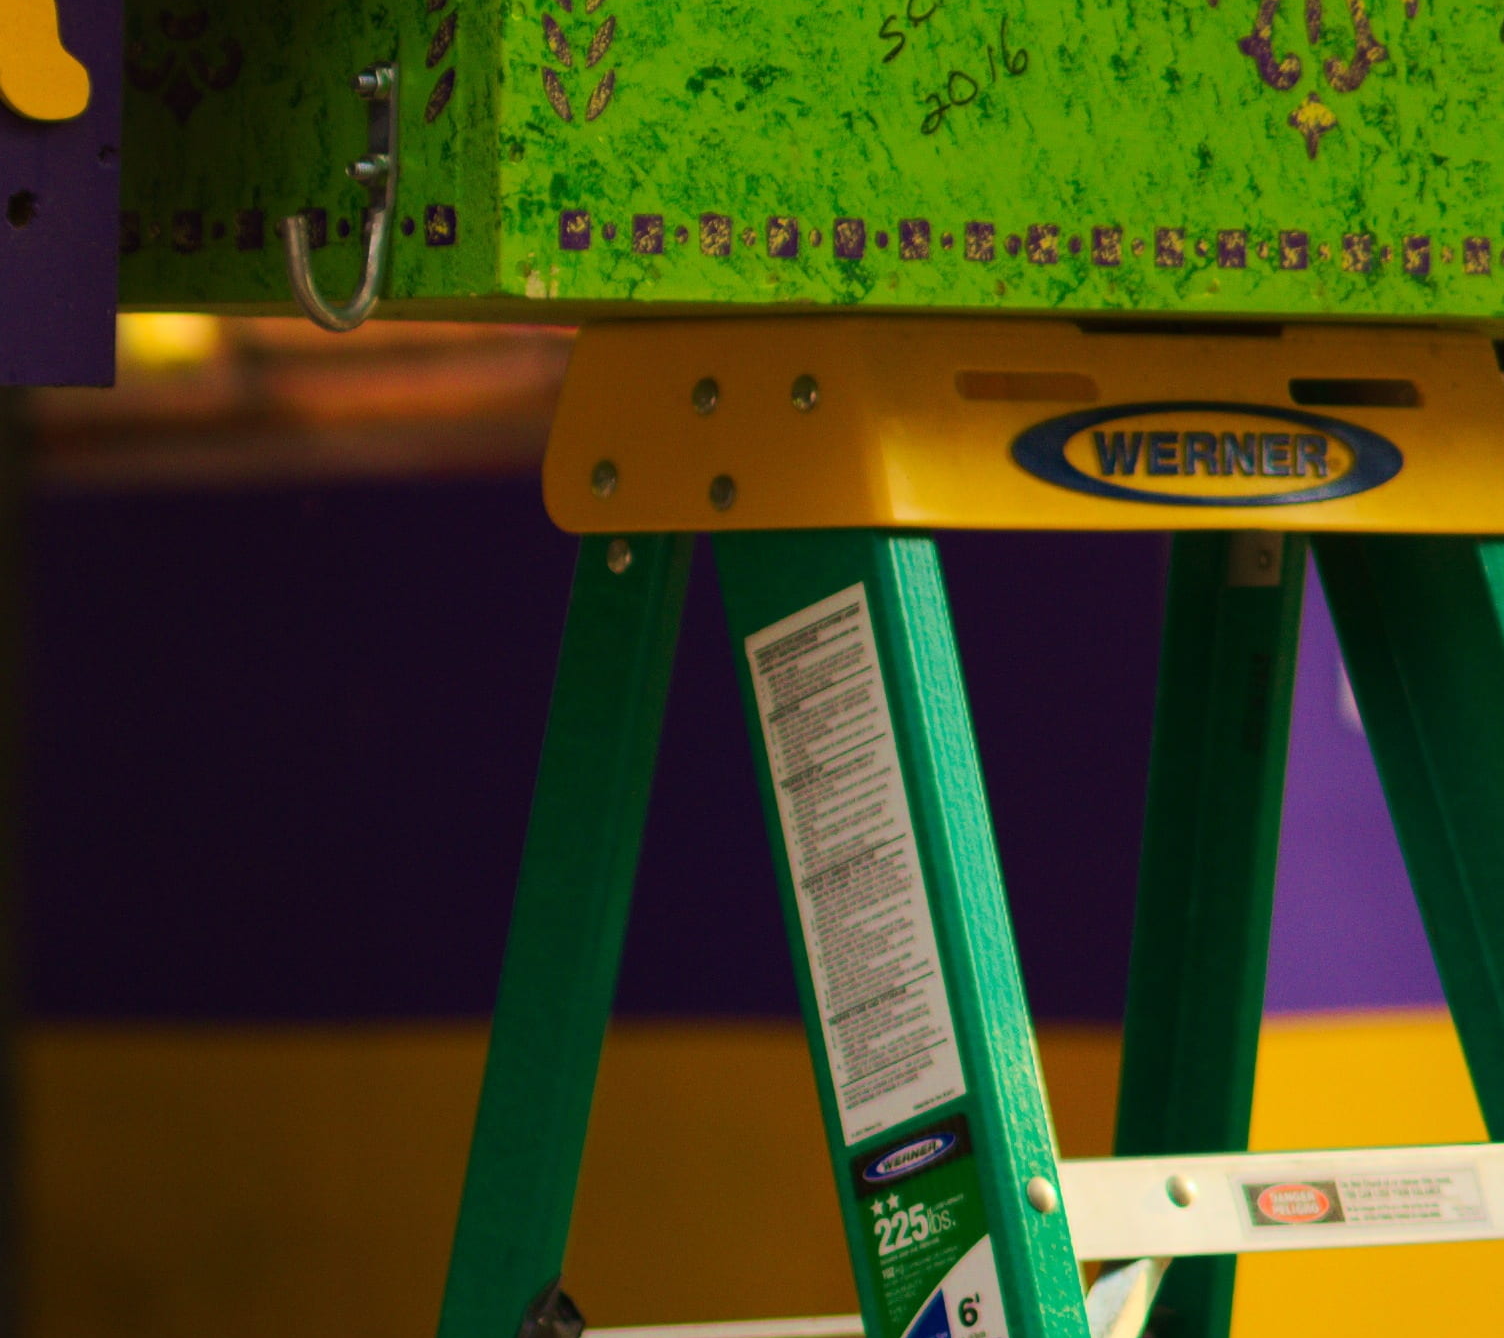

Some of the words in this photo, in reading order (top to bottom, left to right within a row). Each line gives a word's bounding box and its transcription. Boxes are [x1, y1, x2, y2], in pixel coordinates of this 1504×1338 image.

[920, 14, 1029, 136] 2016
[1093, 431, 1330, 477] WERNER
[874, 1203, 929, 1257] 225
[926, 1206, 957, 1234] lbs.
[958, 1293, 981, 1328] 6'
